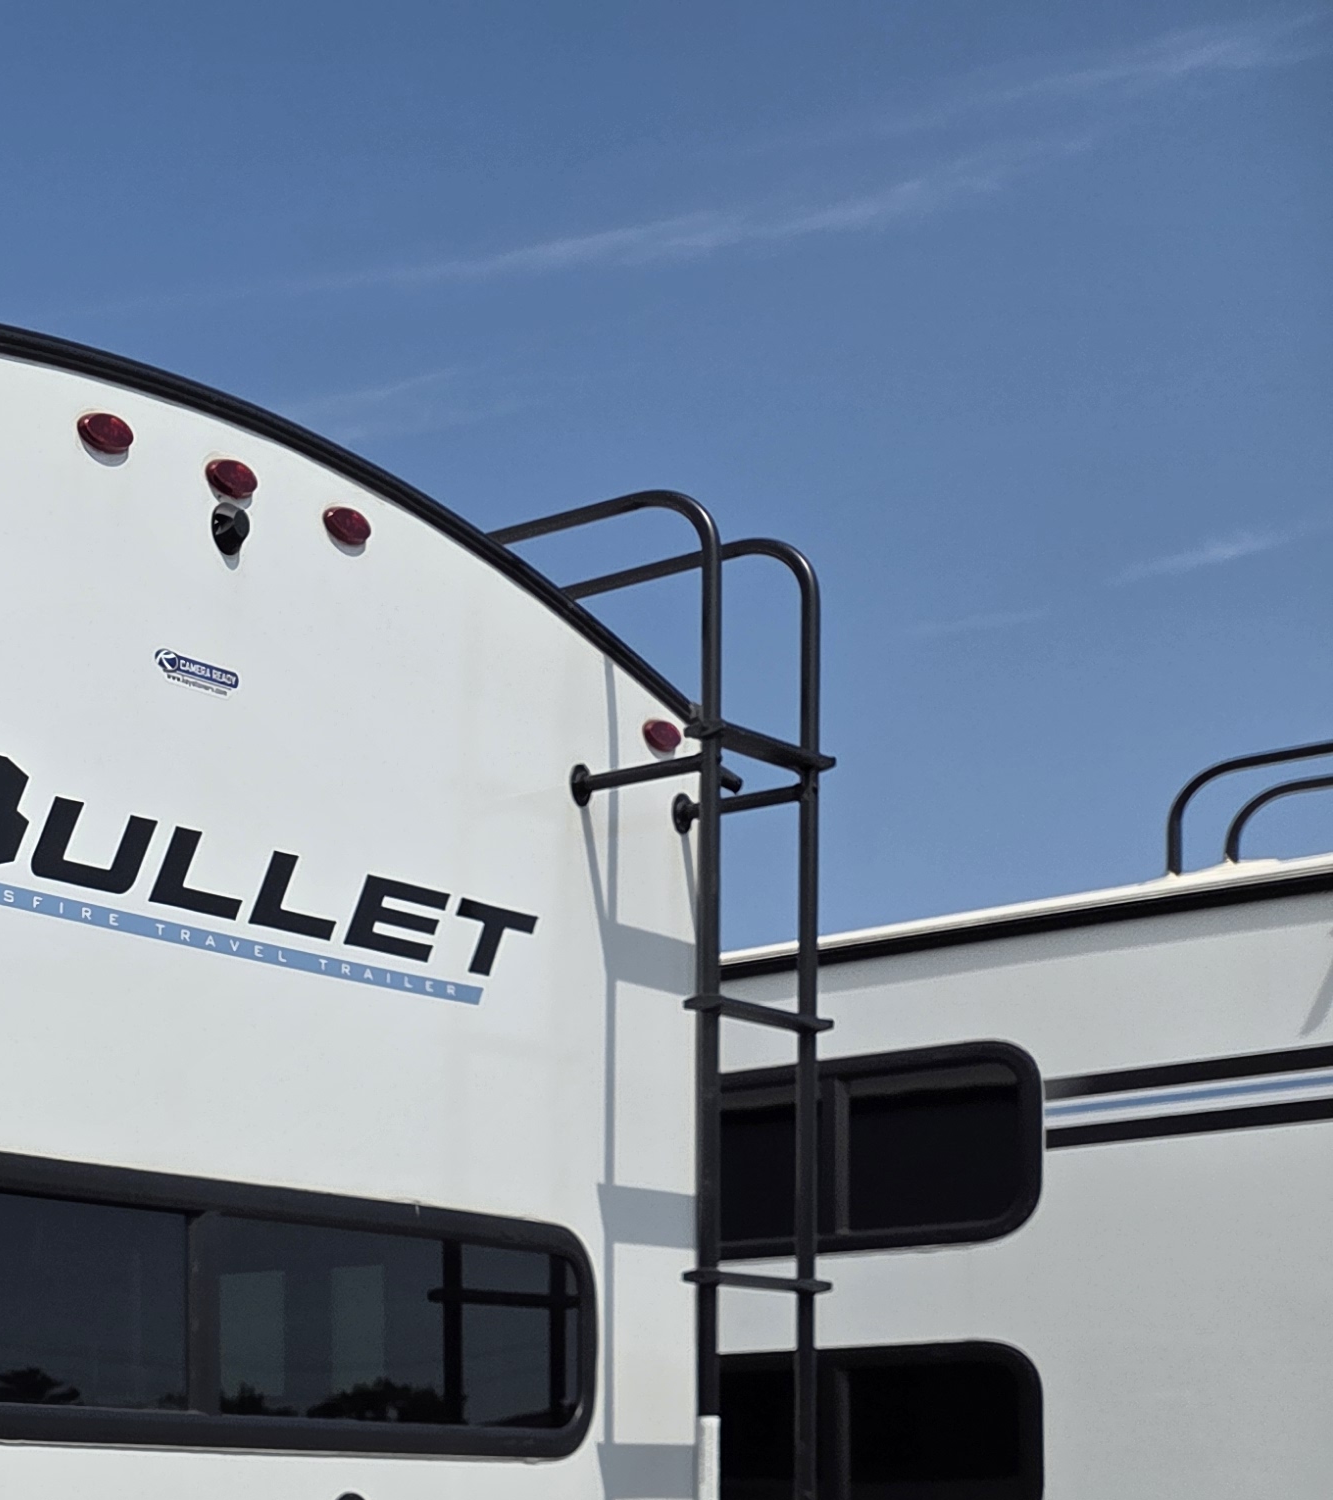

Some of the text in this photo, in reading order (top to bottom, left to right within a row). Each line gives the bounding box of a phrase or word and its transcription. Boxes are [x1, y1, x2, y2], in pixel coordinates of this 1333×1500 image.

[179, 659, 211, 678] CAMERA
[212, 668, 237, 686] READY
[156, 923, 287, 963] TRAVEL
[319, 958, 456, 997] TRAILER
